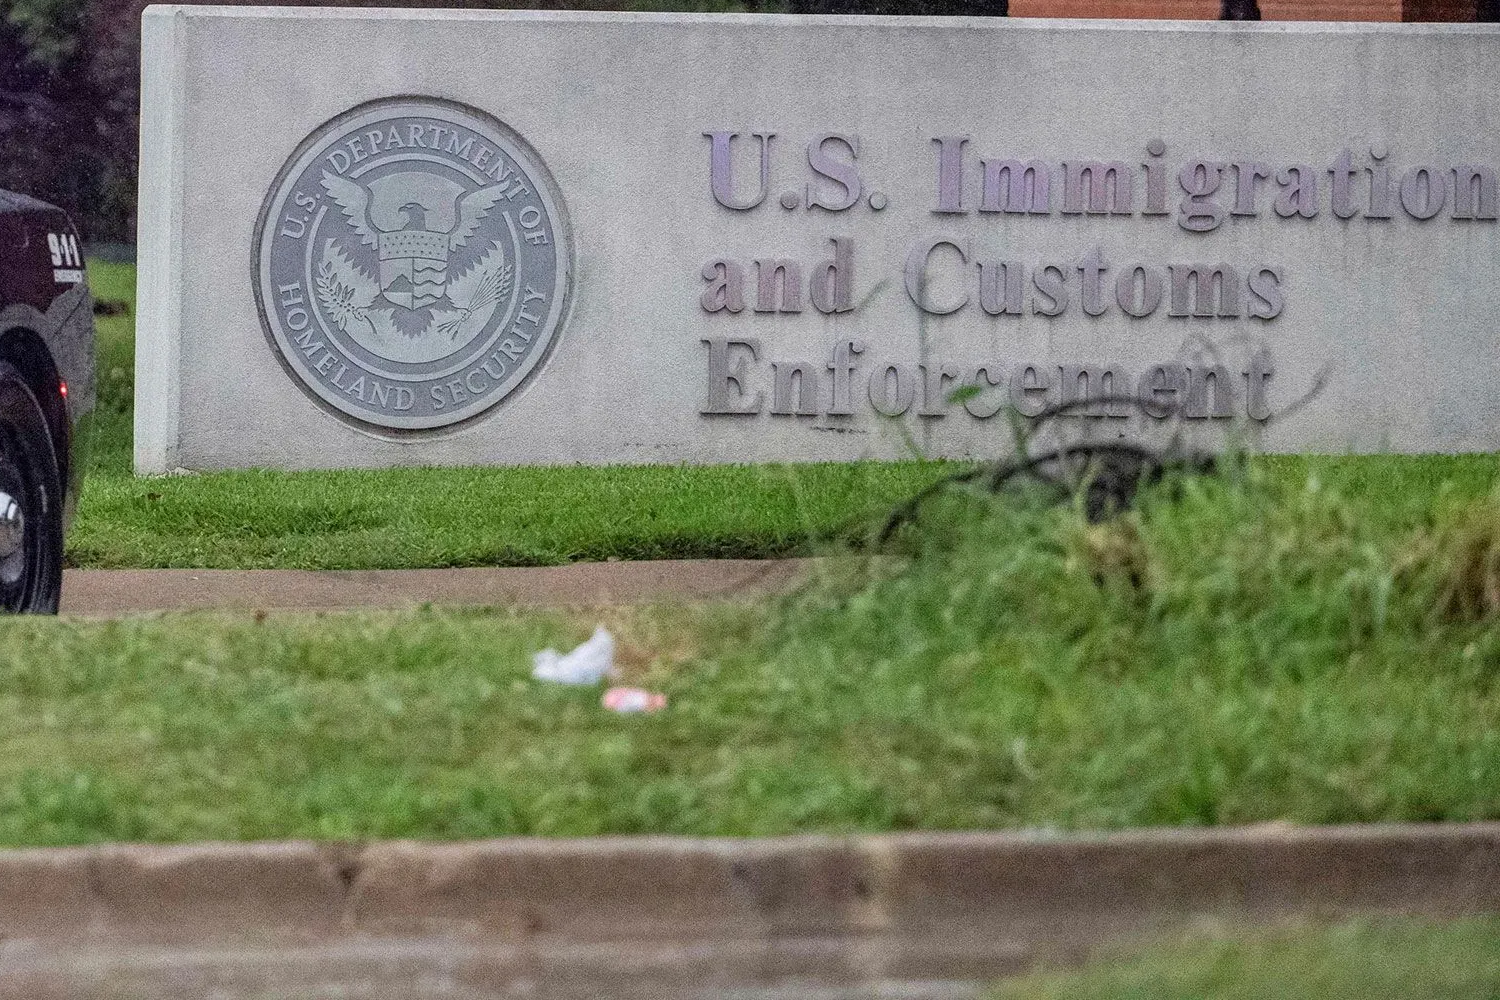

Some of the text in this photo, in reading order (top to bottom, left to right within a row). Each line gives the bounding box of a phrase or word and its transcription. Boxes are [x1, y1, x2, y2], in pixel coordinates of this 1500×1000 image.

[281, 124, 550, 247] U.S. DEPARTMENT OF
[702, 130, 1498, 233] U.S. Immigration
[700, 238, 1283, 320] and Customs
[279, 280, 548, 411] HOMELAND SECURITY
[700, 337, 1275, 423] Enforcement
